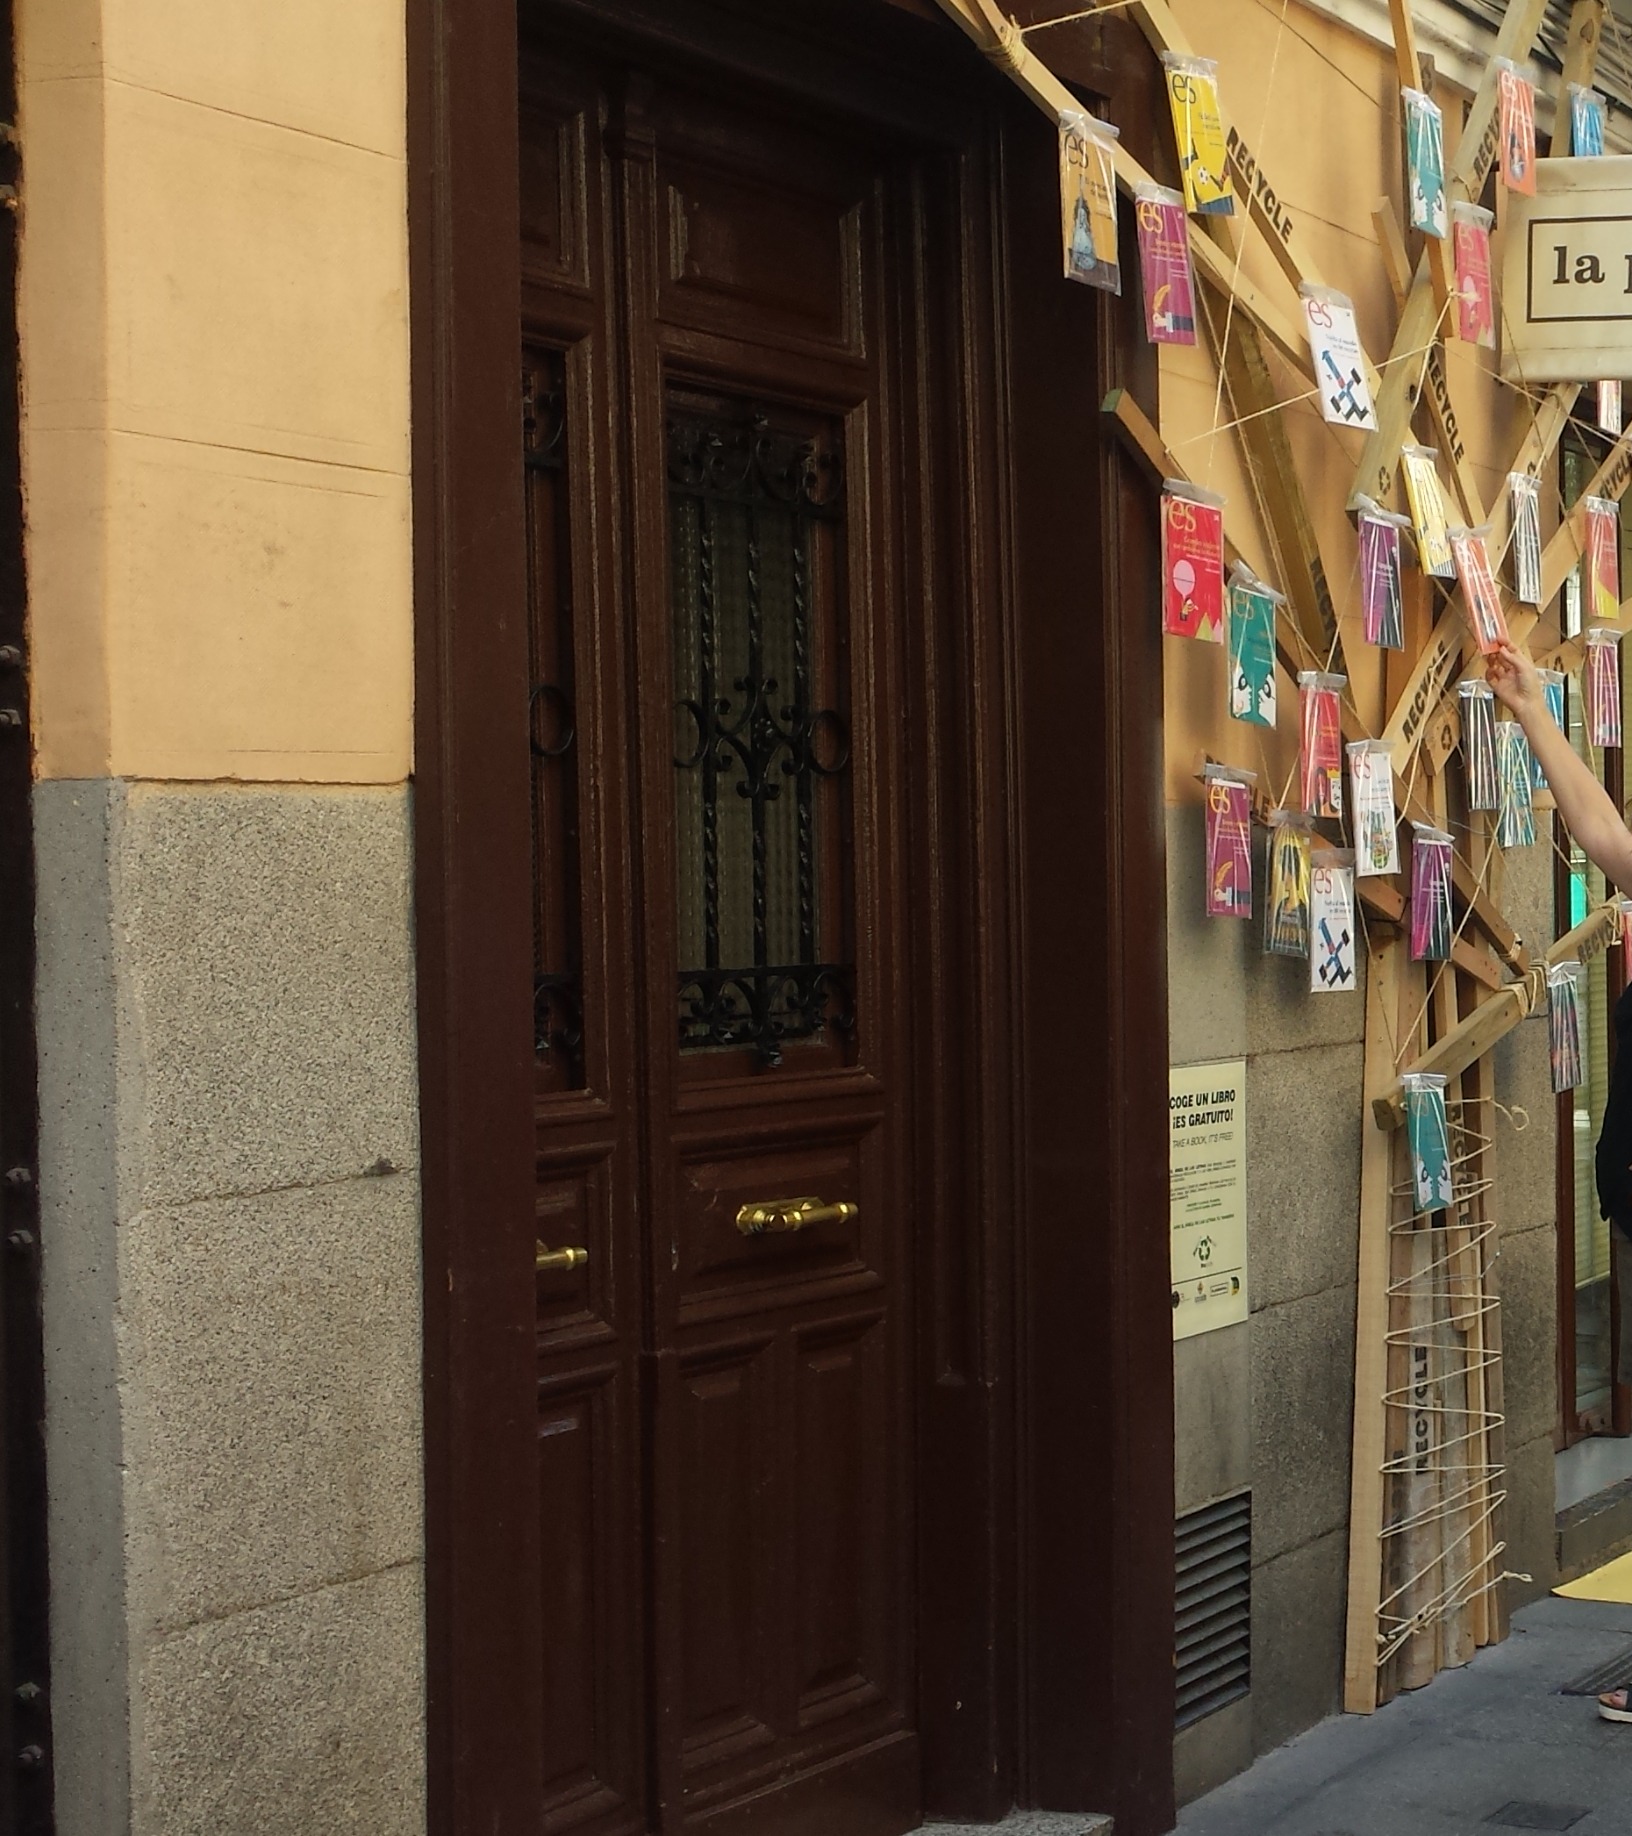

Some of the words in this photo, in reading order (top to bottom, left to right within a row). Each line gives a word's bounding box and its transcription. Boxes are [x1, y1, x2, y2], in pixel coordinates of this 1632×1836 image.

[1171, 73, 1197, 105] es
[1064, 133, 1089, 169] es
[1226, 125, 1293, 244] RECYCLE
[1140, 201, 1164, 234] es
[1552, 245, 1606, 285] la
[1307, 300, 1333, 329] es
[1599, 450, 1632, 500] ECYCLE
[1169, 500, 1197, 532] es
[1402, 640, 1449, 744] RECYCLE
[1353, 752, 1372, 780] es
[1210, 784, 1232, 815] es
[1313, 867, 1333, 894] es
[1577, 915, 1614, 967] RECYC
[1168, 1095, 1194, 1110] COGE
[1195, 1092, 1209, 1107] UN
[1211, 1089, 1236, 1104] LIBRO
[1172, 1115, 1187, 1130] ¡ES
[1188, 1109, 1234, 1127] GRATUITO!
[1415, 1345, 1429, 1477] RECYCLE
